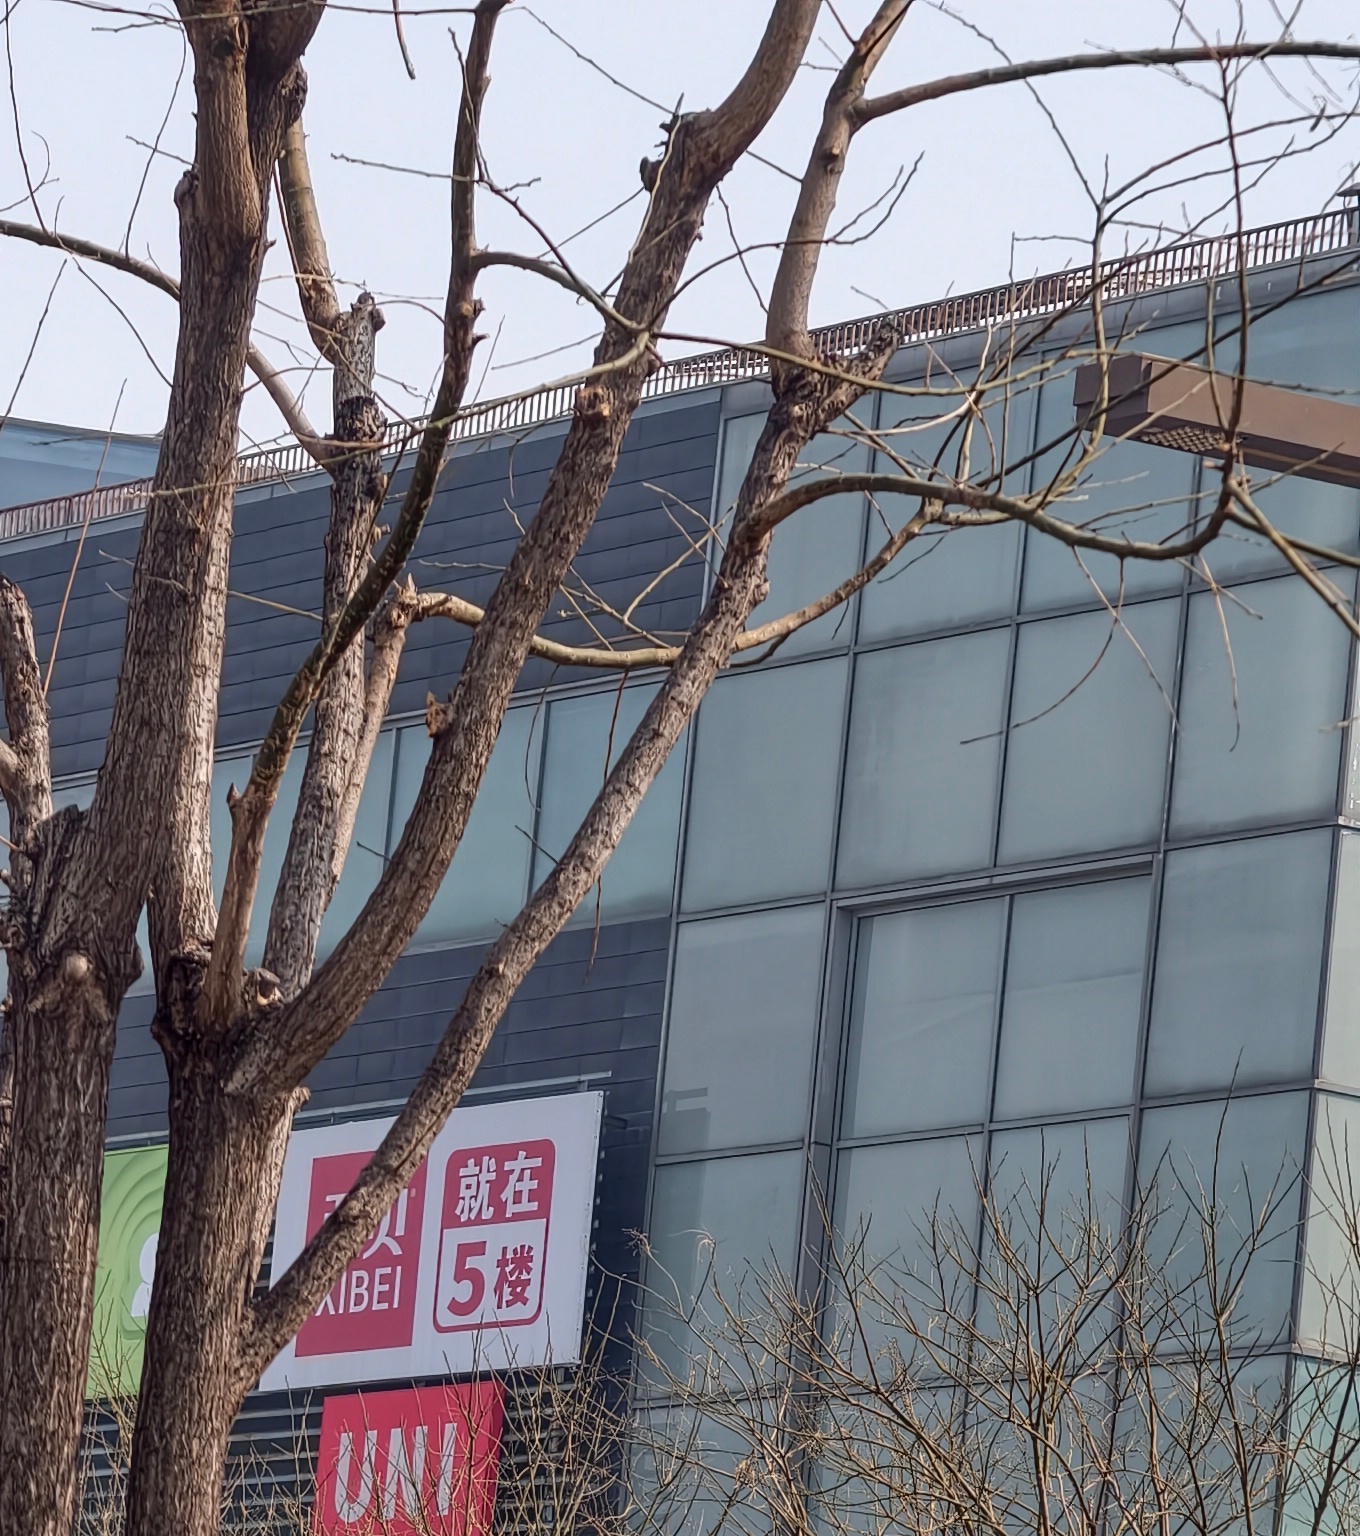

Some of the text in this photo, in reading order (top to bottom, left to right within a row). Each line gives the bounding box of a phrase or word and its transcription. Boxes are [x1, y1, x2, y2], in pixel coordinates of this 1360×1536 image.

[454, 1150, 542, 1222] 就在
[446, 1240, 534, 1317] 5楼
[334, 1422, 458, 1524] UNI
